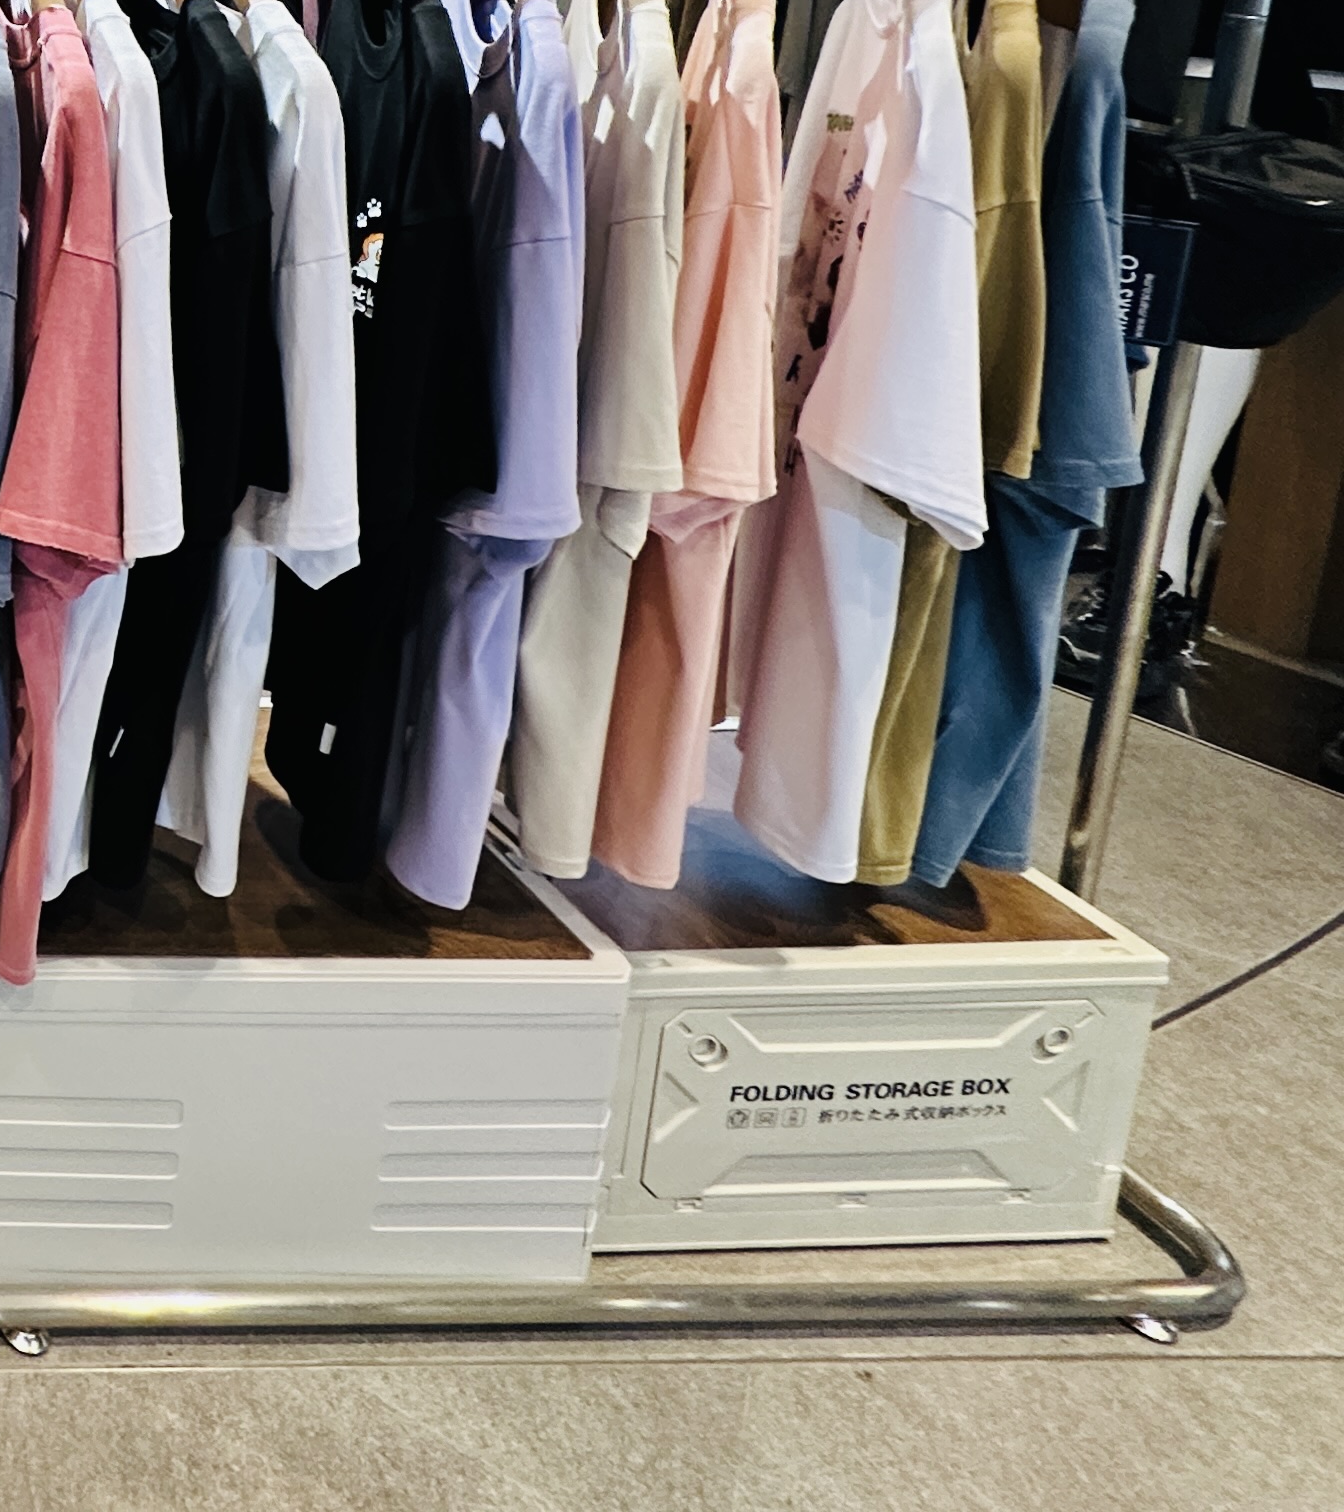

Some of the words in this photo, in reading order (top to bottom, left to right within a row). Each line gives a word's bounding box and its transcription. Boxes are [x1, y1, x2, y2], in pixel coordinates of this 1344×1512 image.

[729, 1084, 835, 1103] FOLDING
[845, 1080, 955, 1101] STORAGE
[961, 1078, 1011, 1096] BOX
